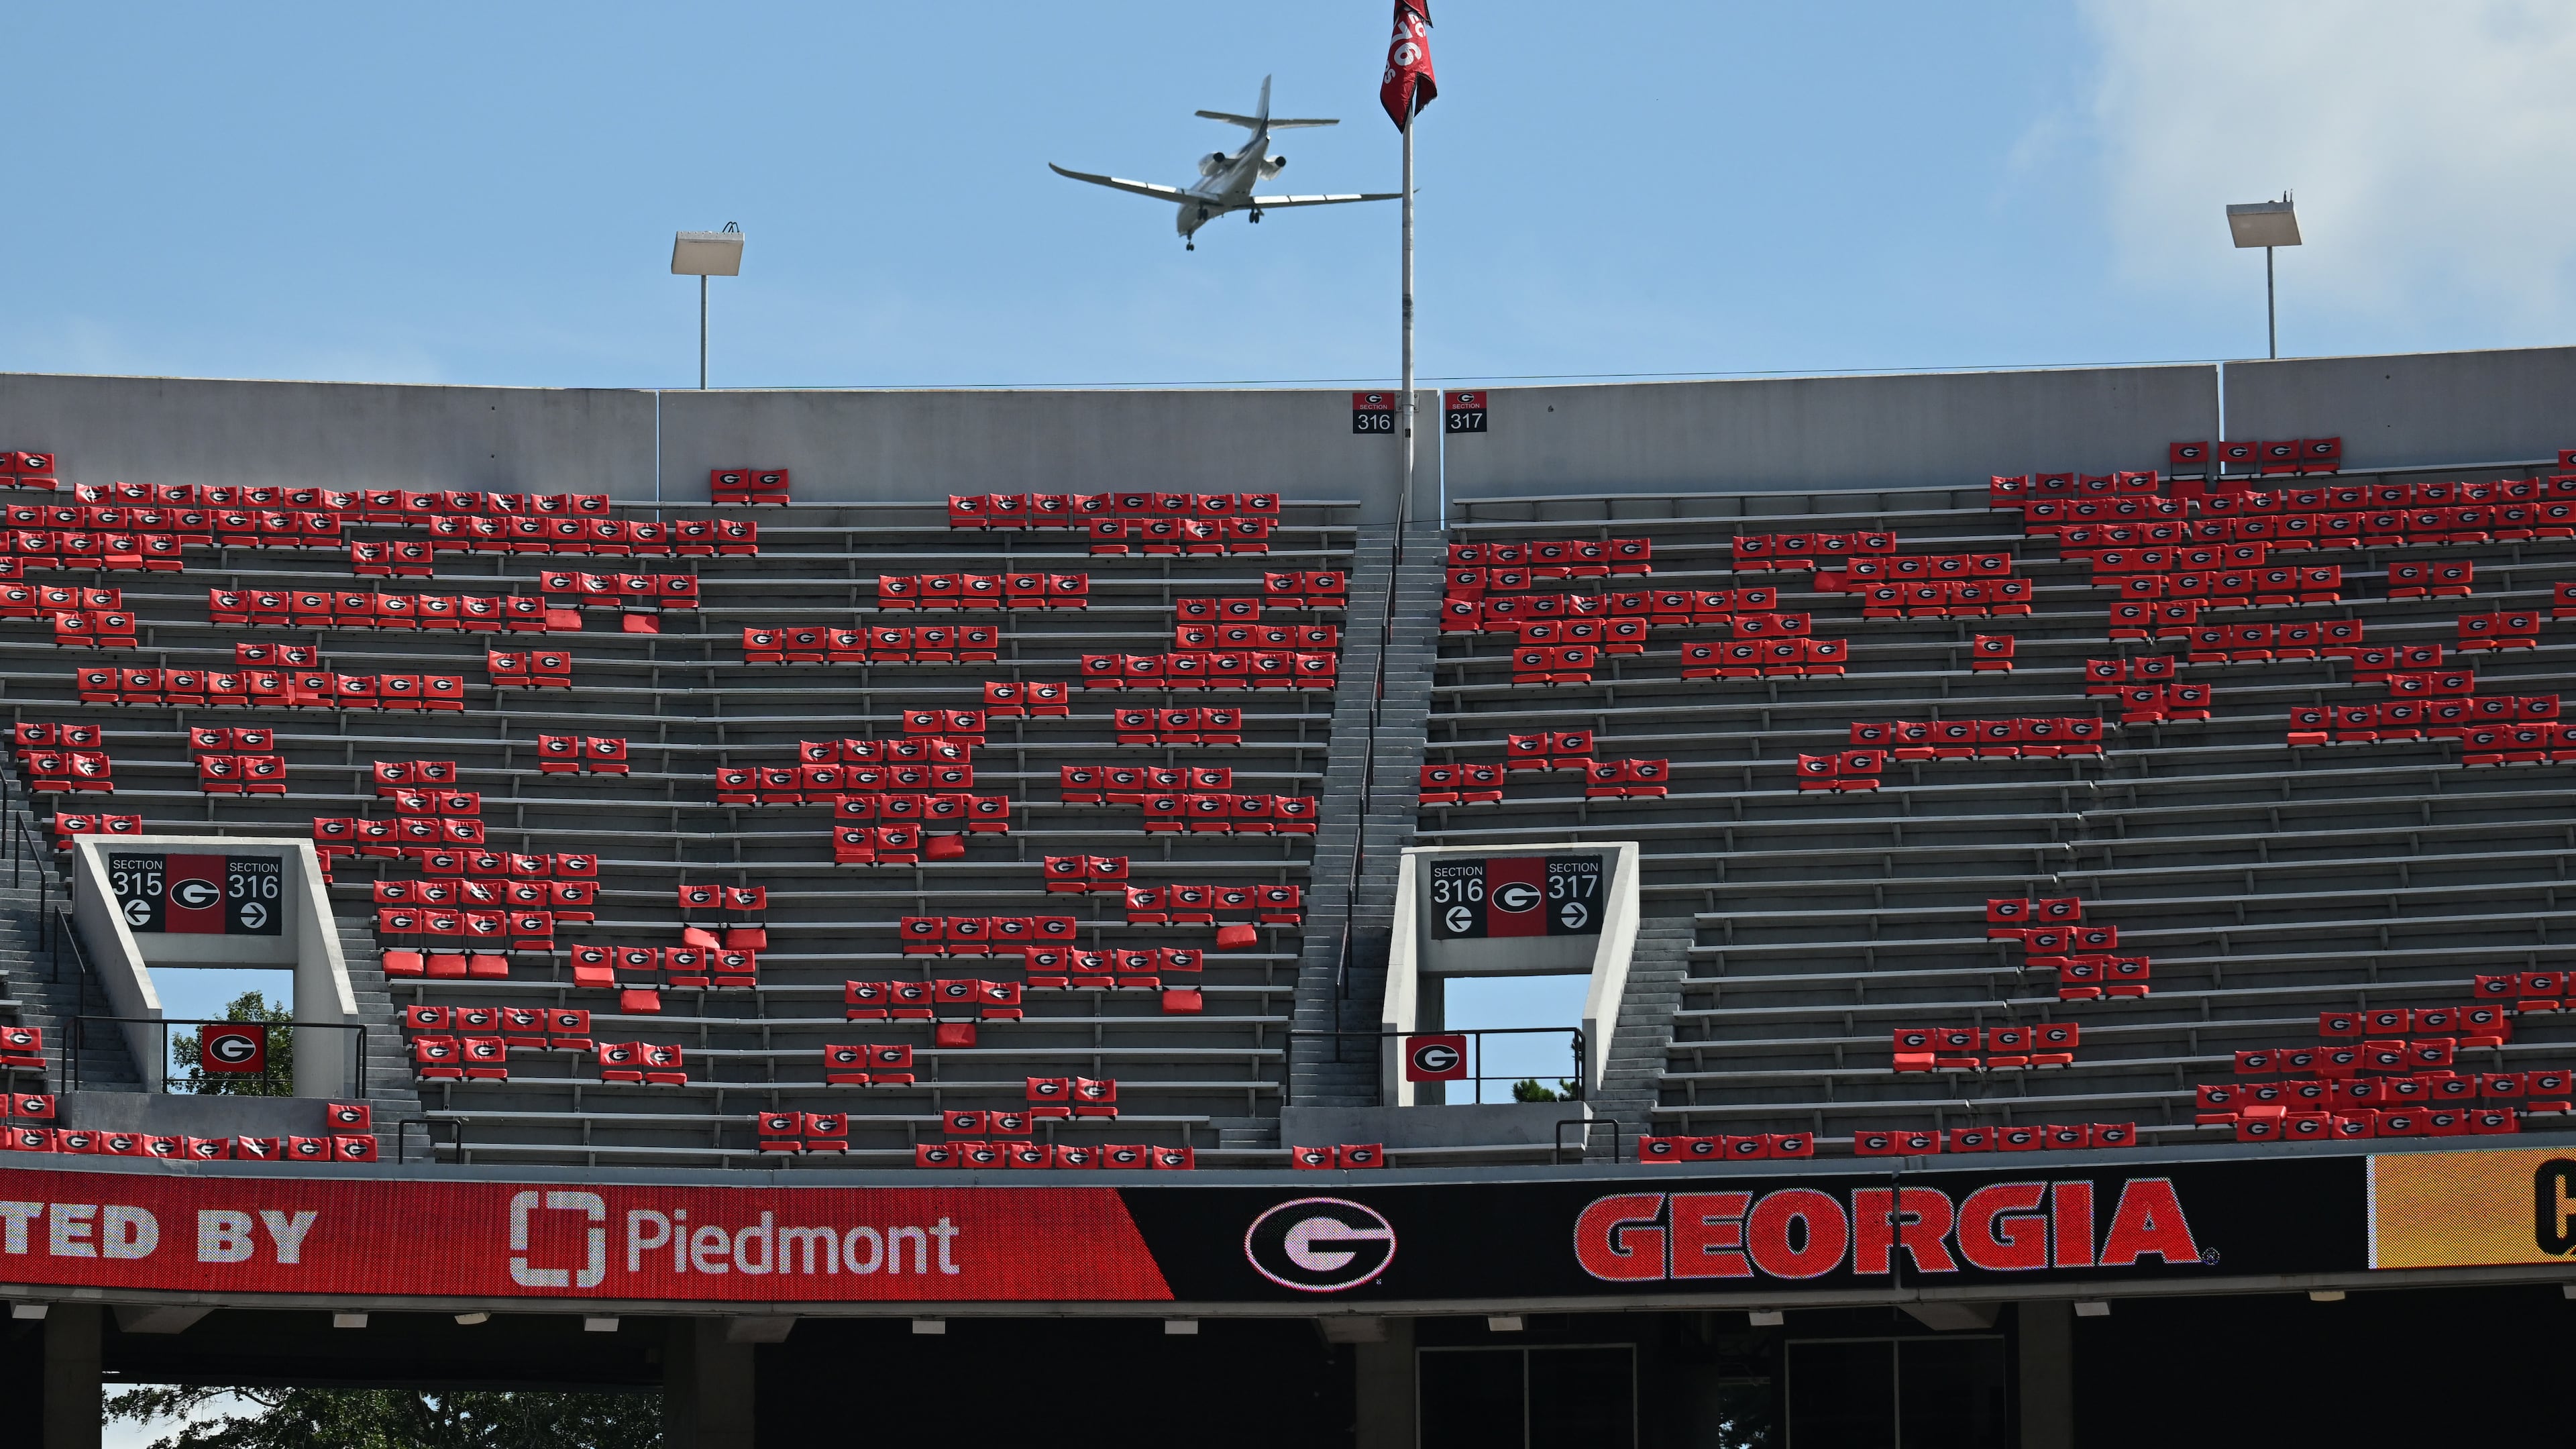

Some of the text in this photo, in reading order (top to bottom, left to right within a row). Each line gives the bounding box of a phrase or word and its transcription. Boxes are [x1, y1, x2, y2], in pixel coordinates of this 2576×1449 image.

[1358, 414, 1391, 430] 316
[1450, 413, 1483, 429] 317
[113, 859, 163, 870] SECTION
[229, 862, 278, 873] SECTION
[1434, 866, 1483, 877] SECTION
[1549, 863, 1599, 873] SECTION
[113, 872, 162, 896] 315
[228, 874, 278, 899] 316
[1434, 878, 1483, 904] 316
[1548, 874, 1597, 899] 317
[197, 1209, 318, 1265] BY
[627, 1208, 961, 1275] Piedmont
[1574, 1177, 2202, 1282] GEORGIA
